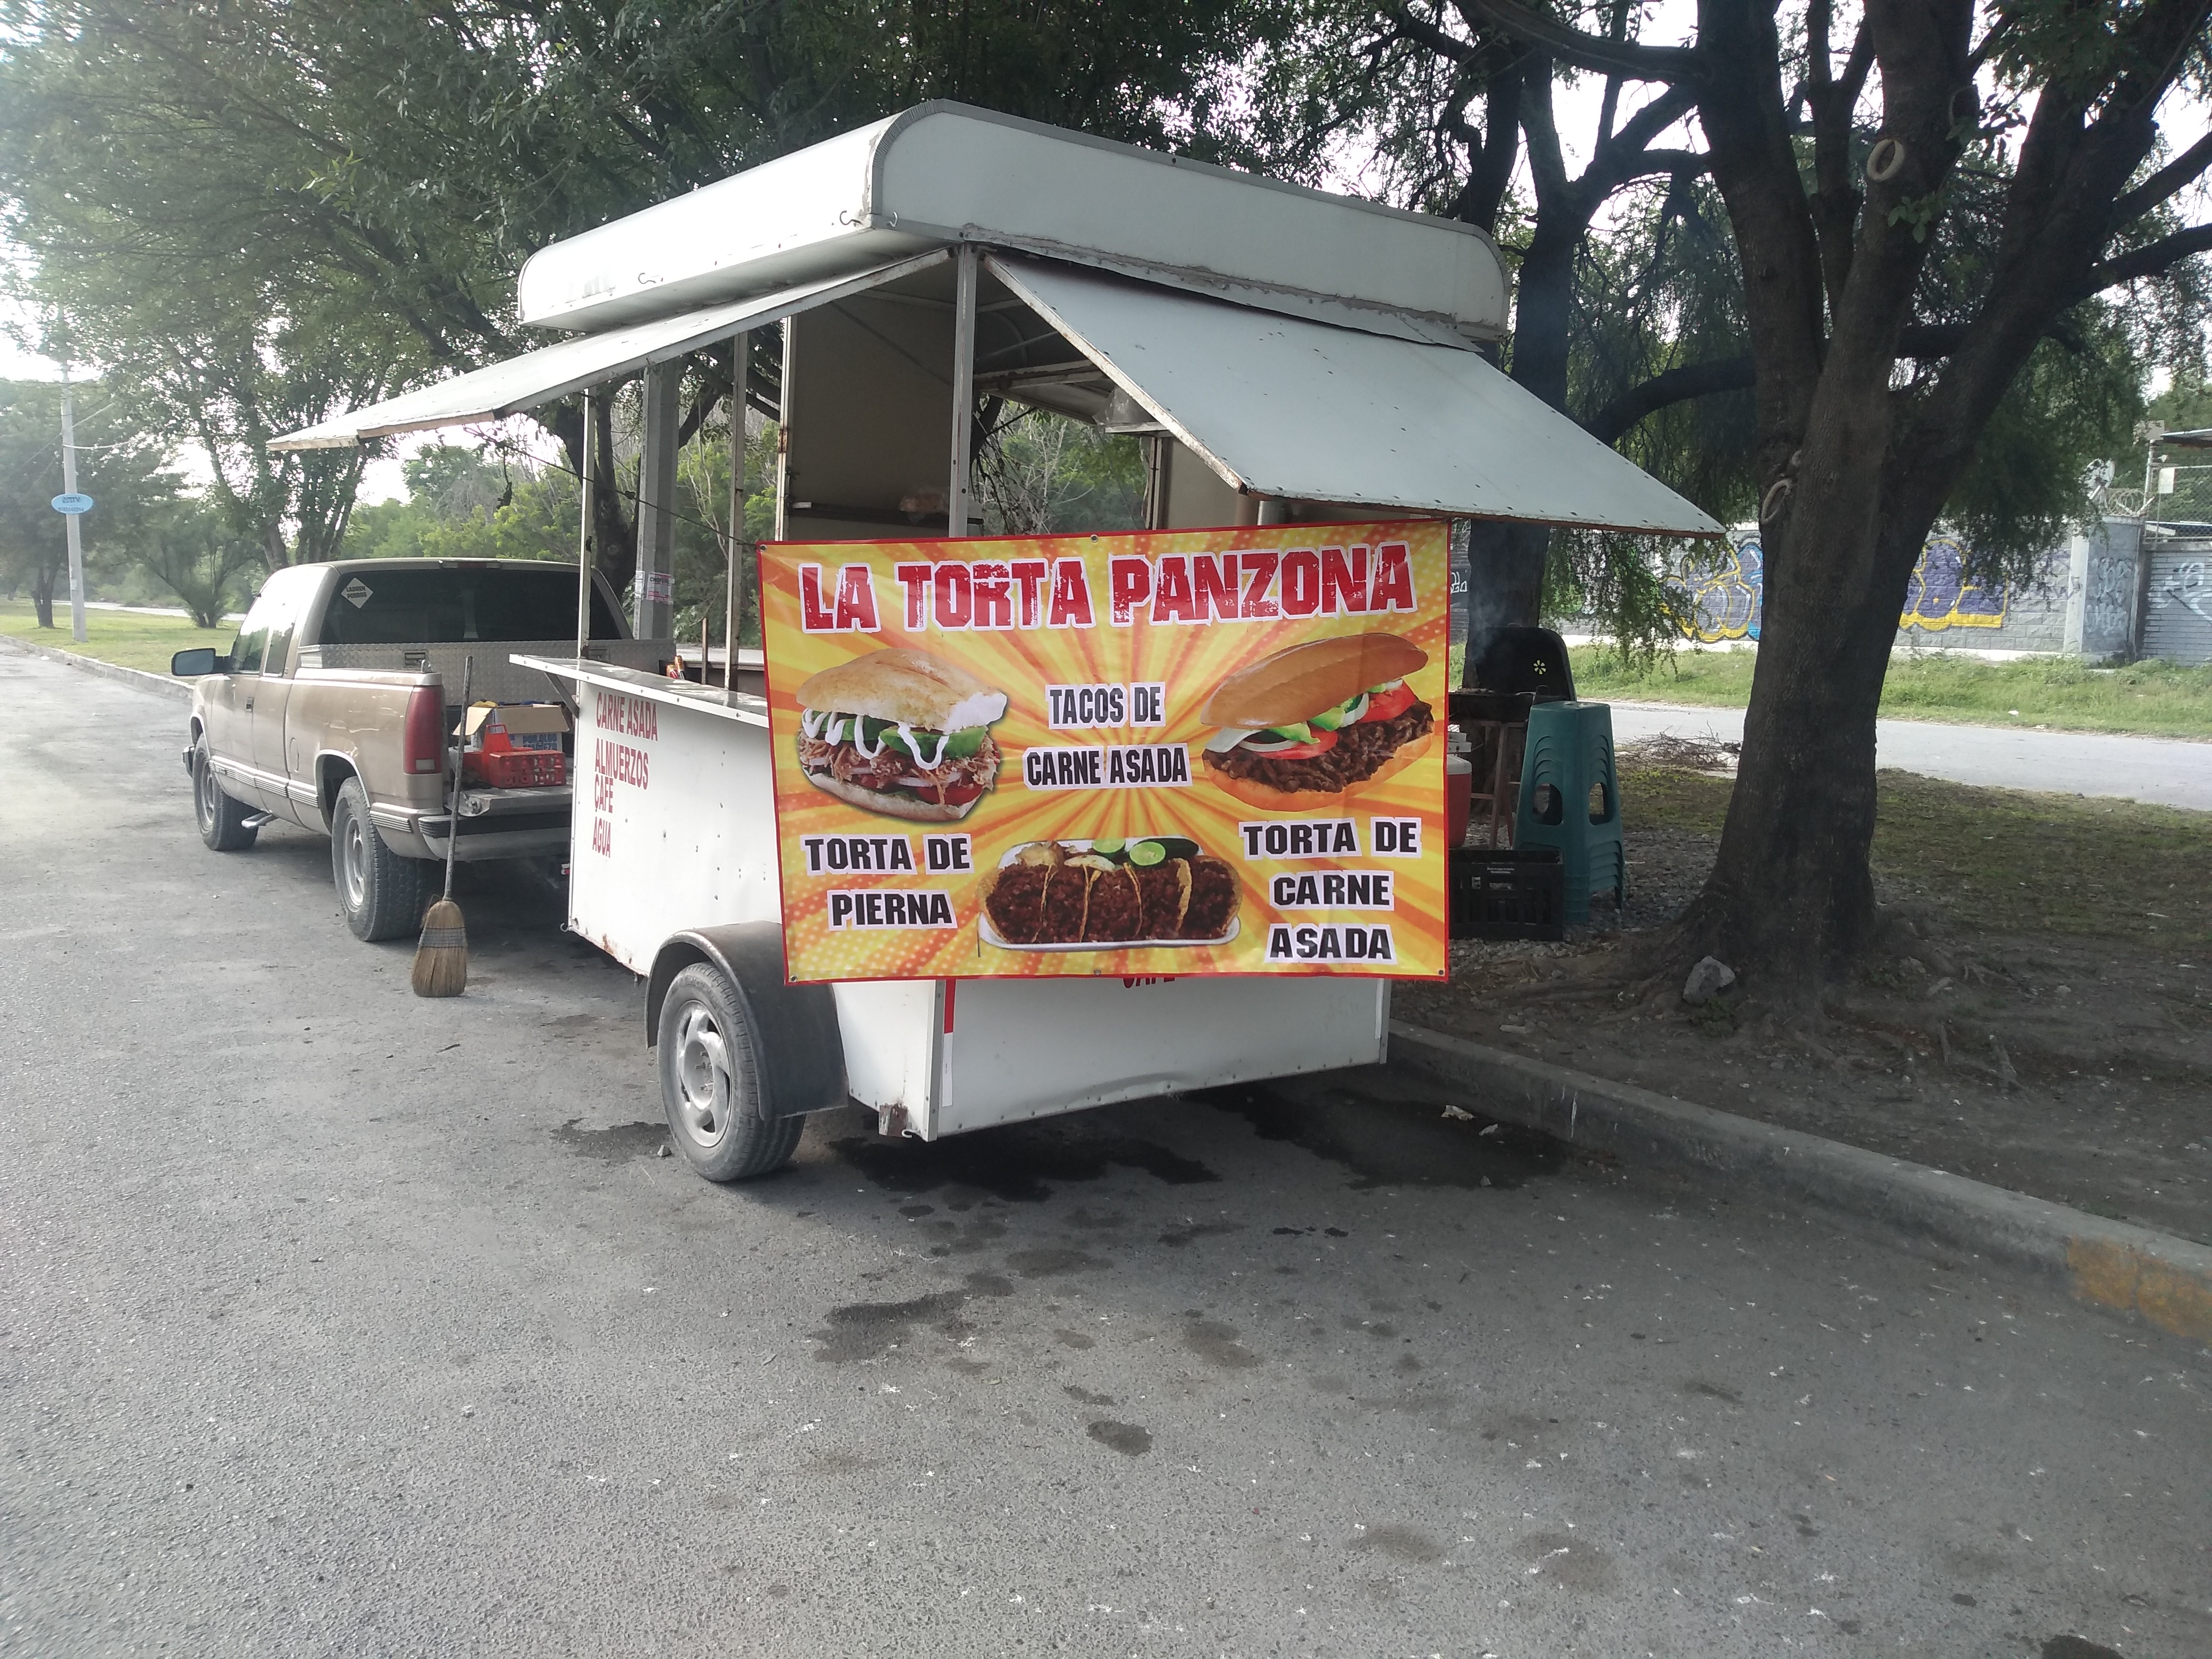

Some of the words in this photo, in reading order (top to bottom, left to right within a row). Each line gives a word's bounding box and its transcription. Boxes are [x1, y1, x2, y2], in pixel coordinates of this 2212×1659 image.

[801, 565, 878, 631] LA
[897, 559, 1094, 630] TORTA
[1110, 543, 1415, 624] PANZONA
[596, 691, 625, 733] CARNE
[626, 698, 659, 741] ASADA
[1049, 688, 1124, 724] TACOS
[1134, 686, 1161, 722] DE
[594, 738, 649, 790] ALMUERZOS
[1026, 750, 1102, 786] CARNE
[1109, 747, 1188, 784] ASADA
[594, 774, 614, 813] CAFE
[592, 816, 611, 858] AGUA
[804, 837, 913, 872] TORTA
[927, 837, 970, 870] DE
[1243, 822, 1357, 856] TORTA
[1375, 821, 1418, 853] DE
[1273, 874, 1390, 906] CARNE
[831, 893, 953, 926] PIERNA
[1269, 927, 1393, 960] ASADA
